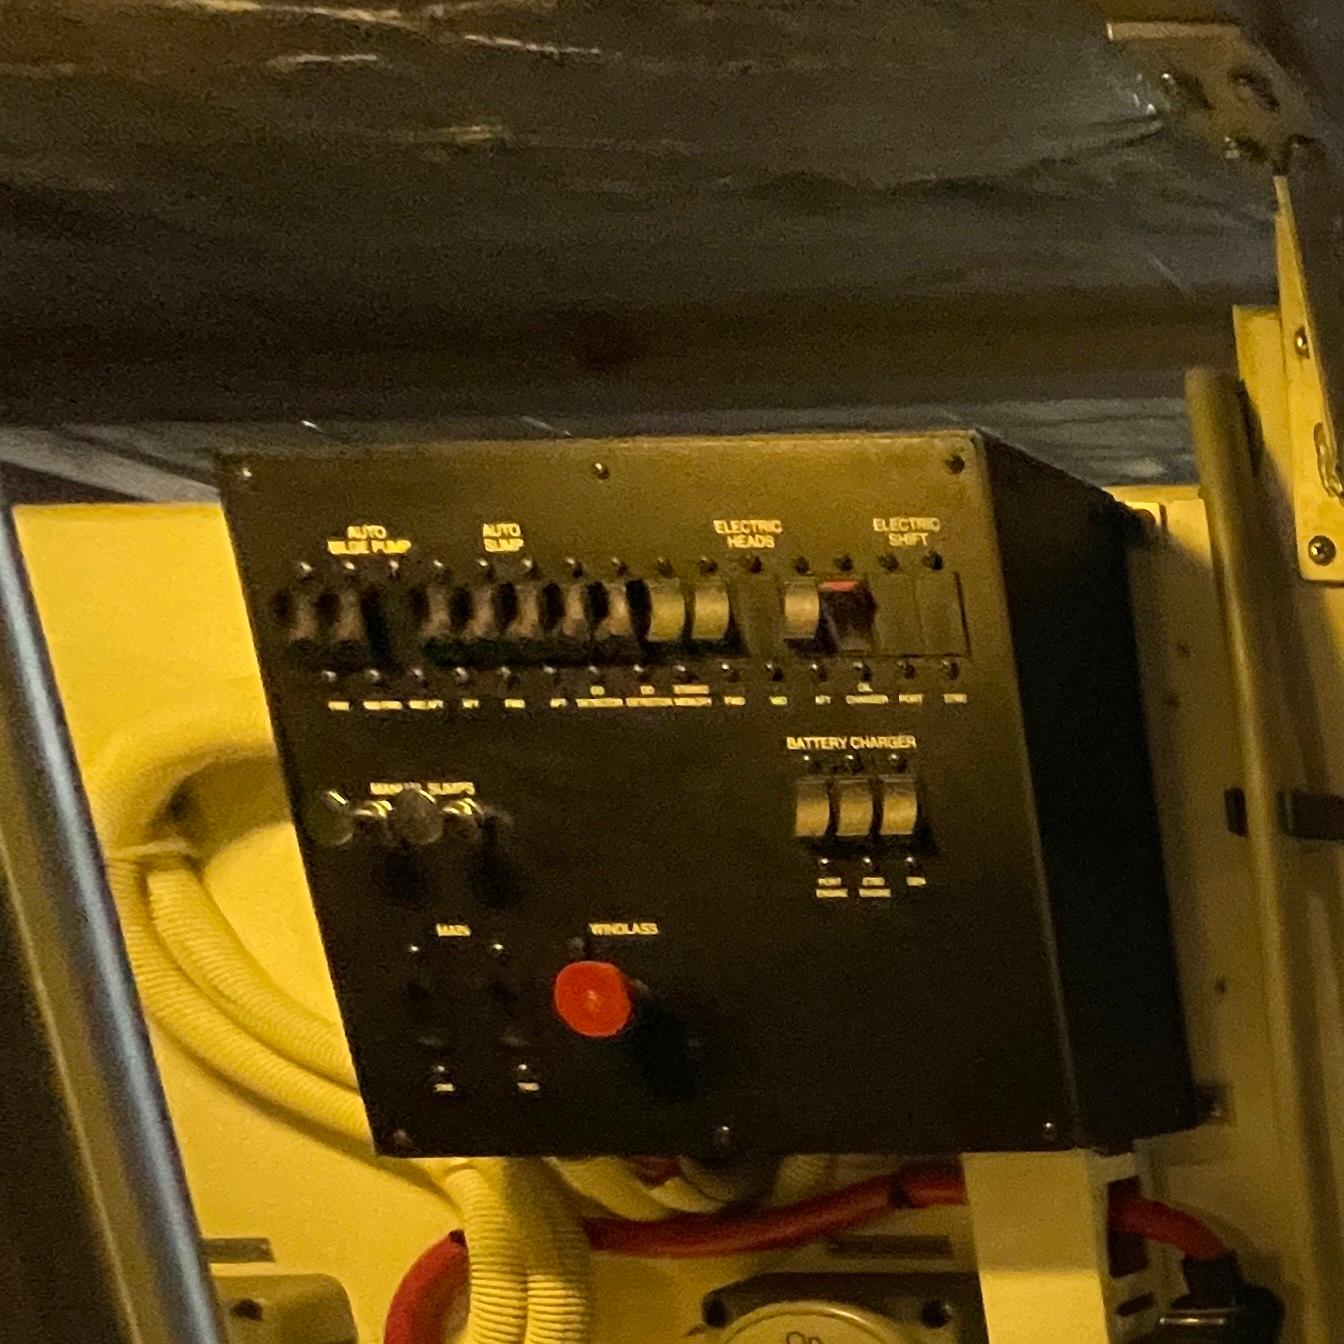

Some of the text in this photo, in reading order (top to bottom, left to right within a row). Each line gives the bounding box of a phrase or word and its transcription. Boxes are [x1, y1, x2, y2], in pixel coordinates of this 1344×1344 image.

[482, 523, 521, 537] AUTO
[713, 519, 783, 534] ELECTRIC
[872, 517, 940, 532] ELECTRIC
[347, 525, 387, 539] AUTO
[727, 535, 775, 548] HEADS
[889, 533, 928, 546] SHIFT
[786, 734, 917, 750] BATTERY CHARGER
[589, 922, 659, 936] WINDLASS
